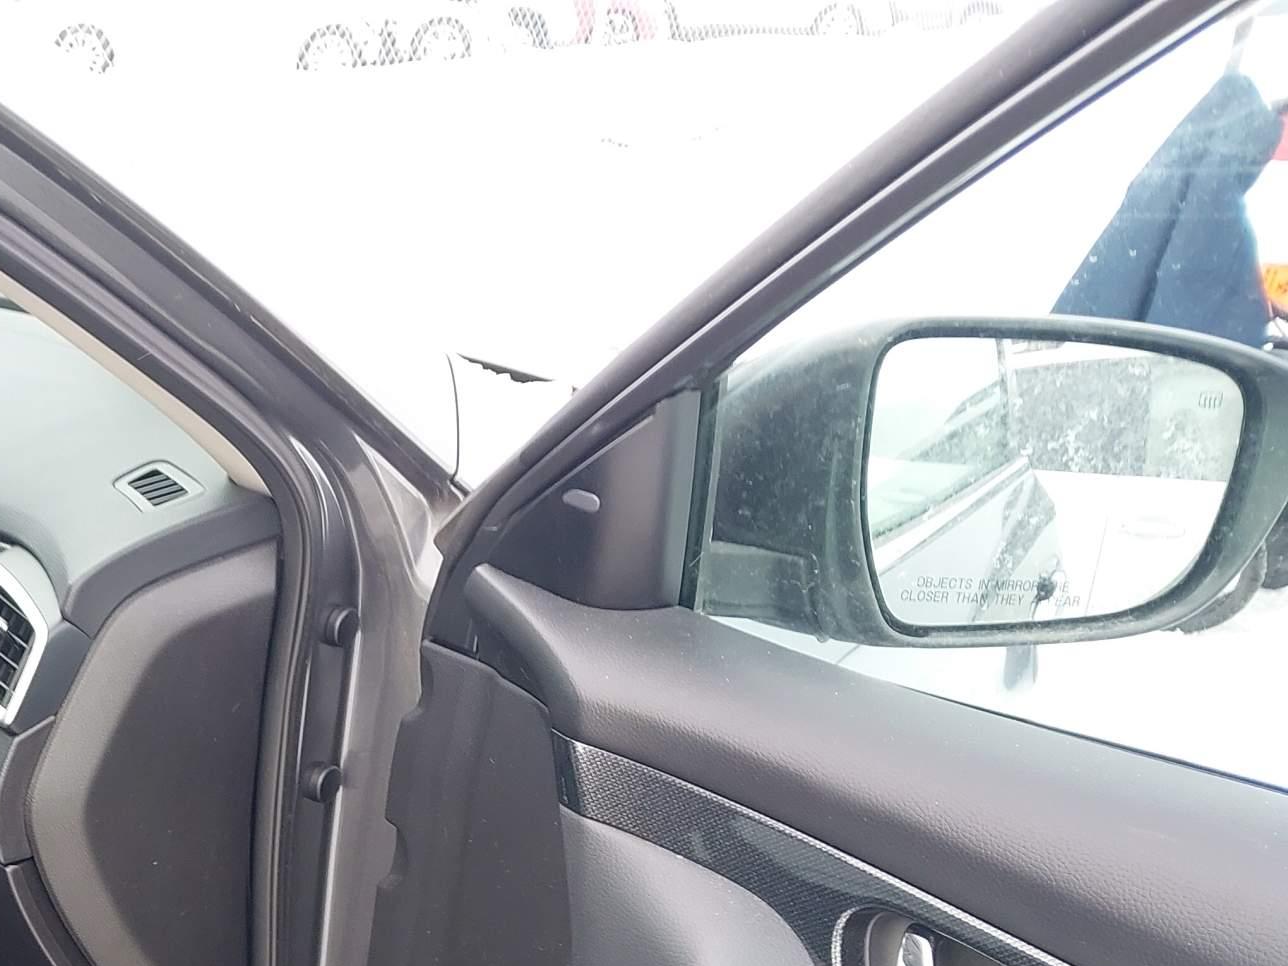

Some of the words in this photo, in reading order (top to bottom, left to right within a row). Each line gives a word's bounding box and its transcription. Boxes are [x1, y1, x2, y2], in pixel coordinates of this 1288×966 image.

[916, 575, 973, 590] OBJECTS
[978, 578, 991, 591] IN
[900, 588, 949, 603] CLOSER
[956, 591, 990, 606] THAN
[996, 593, 1025, 606] THEY
